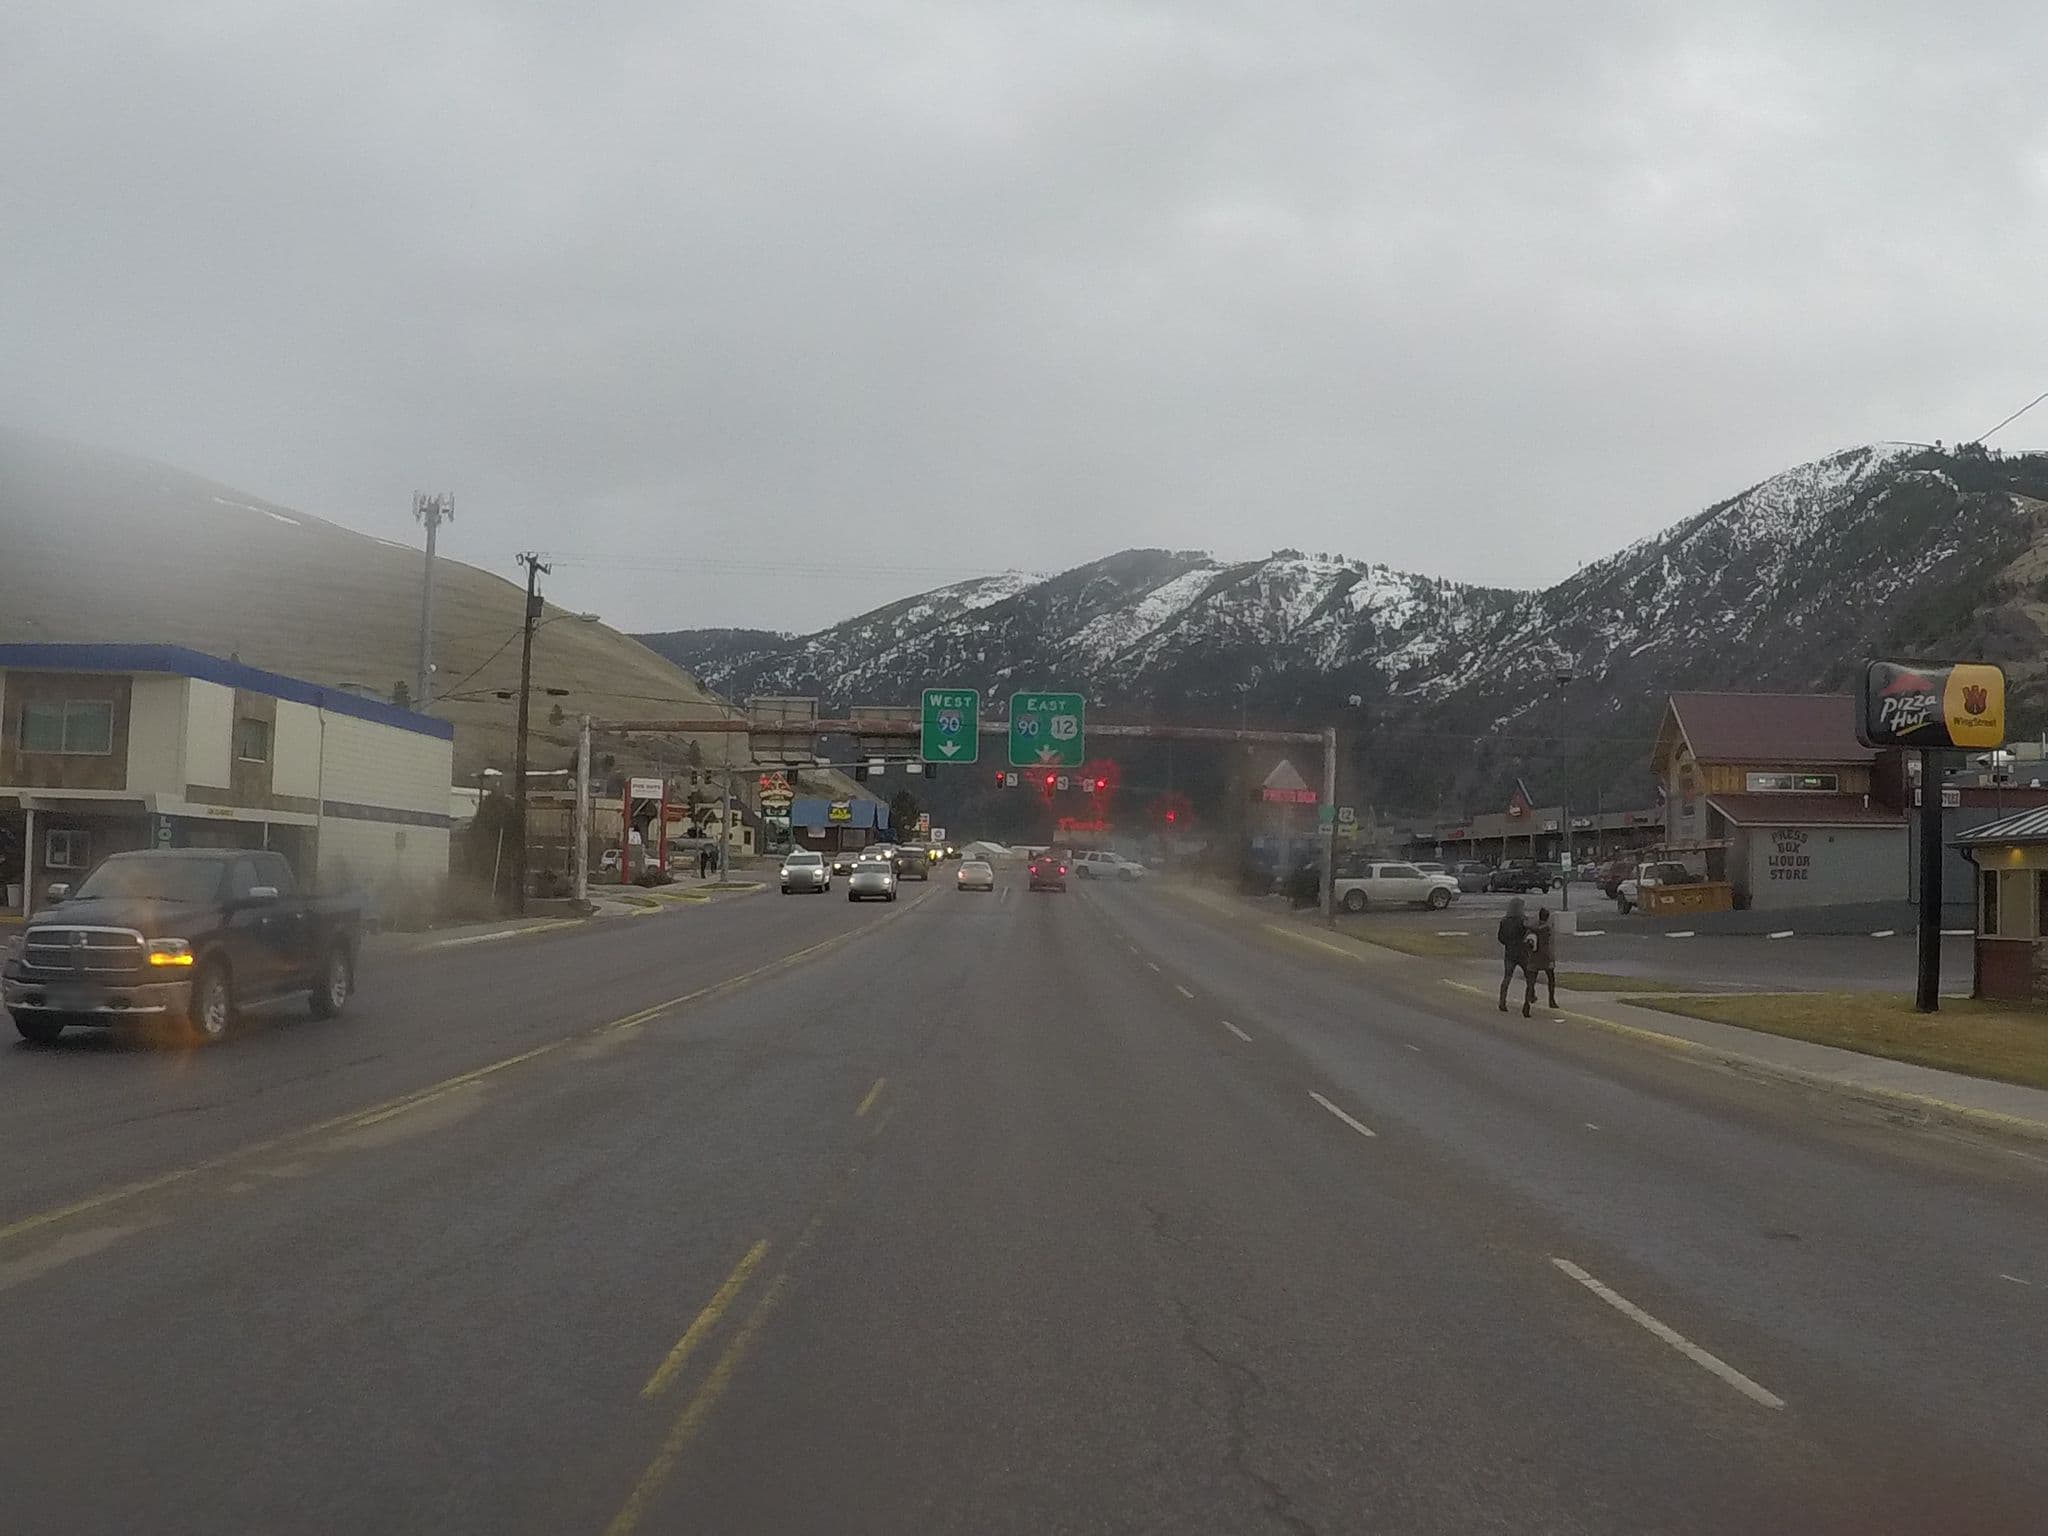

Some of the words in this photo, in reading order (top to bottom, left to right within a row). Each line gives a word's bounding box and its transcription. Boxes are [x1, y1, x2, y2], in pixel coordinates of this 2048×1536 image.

[930, 694, 972, 708] WEST
[1026, 699, 1066, 711] EAST
[1880, 694, 1937, 723] Pizza
[938, 716, 961, 732] 90
[1017, 720, 1039, 736] 90
[1055, 720, 1074, 735] 12
[1889, 710, 1933, 732] Hut
[1769, 869, 1809, 880] STORE
